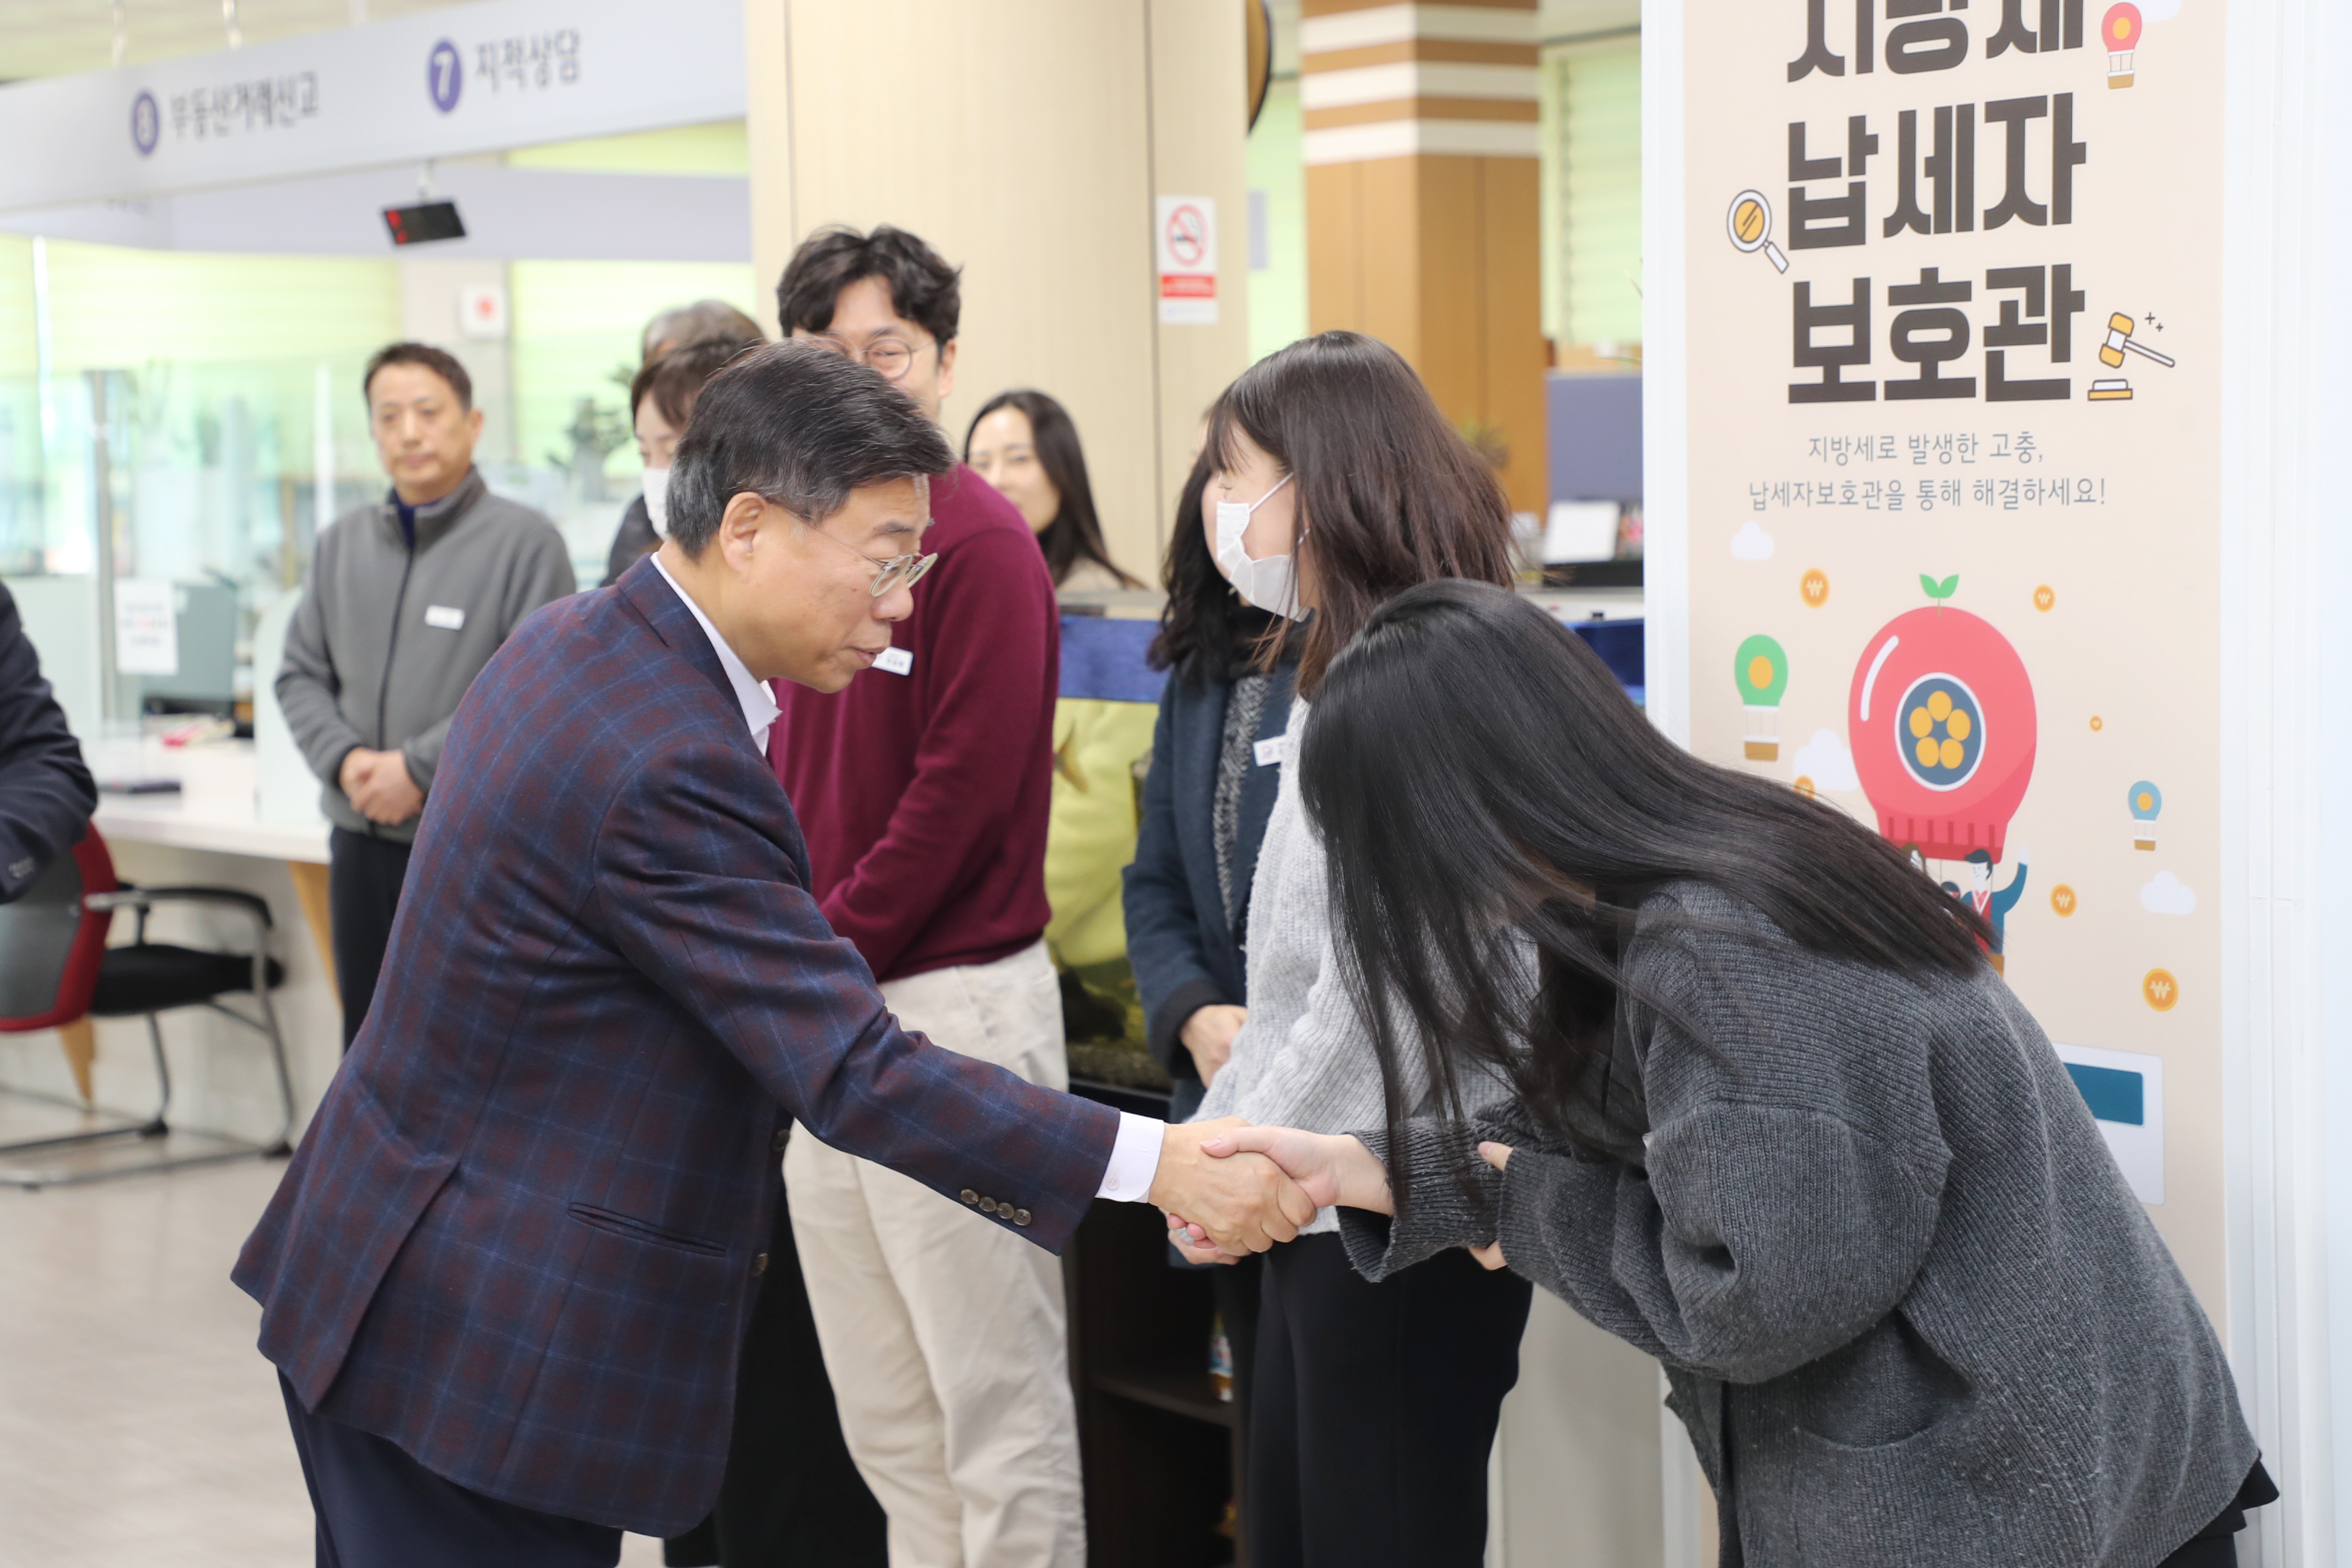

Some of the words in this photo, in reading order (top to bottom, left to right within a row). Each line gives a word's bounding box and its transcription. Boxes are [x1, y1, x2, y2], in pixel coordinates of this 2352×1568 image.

[434, 50, 454, 102] 7
[475, 29, 580, 92] 지적상담
[1787, 92, 2086, 251] 납세자
[1788, 263, 2085, 404] 보호관
[1809, 435, 1898, 466] 지방세로
[1908, 433, 1979, 465] 발생한
[1989, 431, 2043, 464] 고충,
[1749, 479, 1906, 511] 납세자보호관을
[1916, 479, 1961, 511] 통해
[1972, 477, 2105, 510] 해결하세요!
